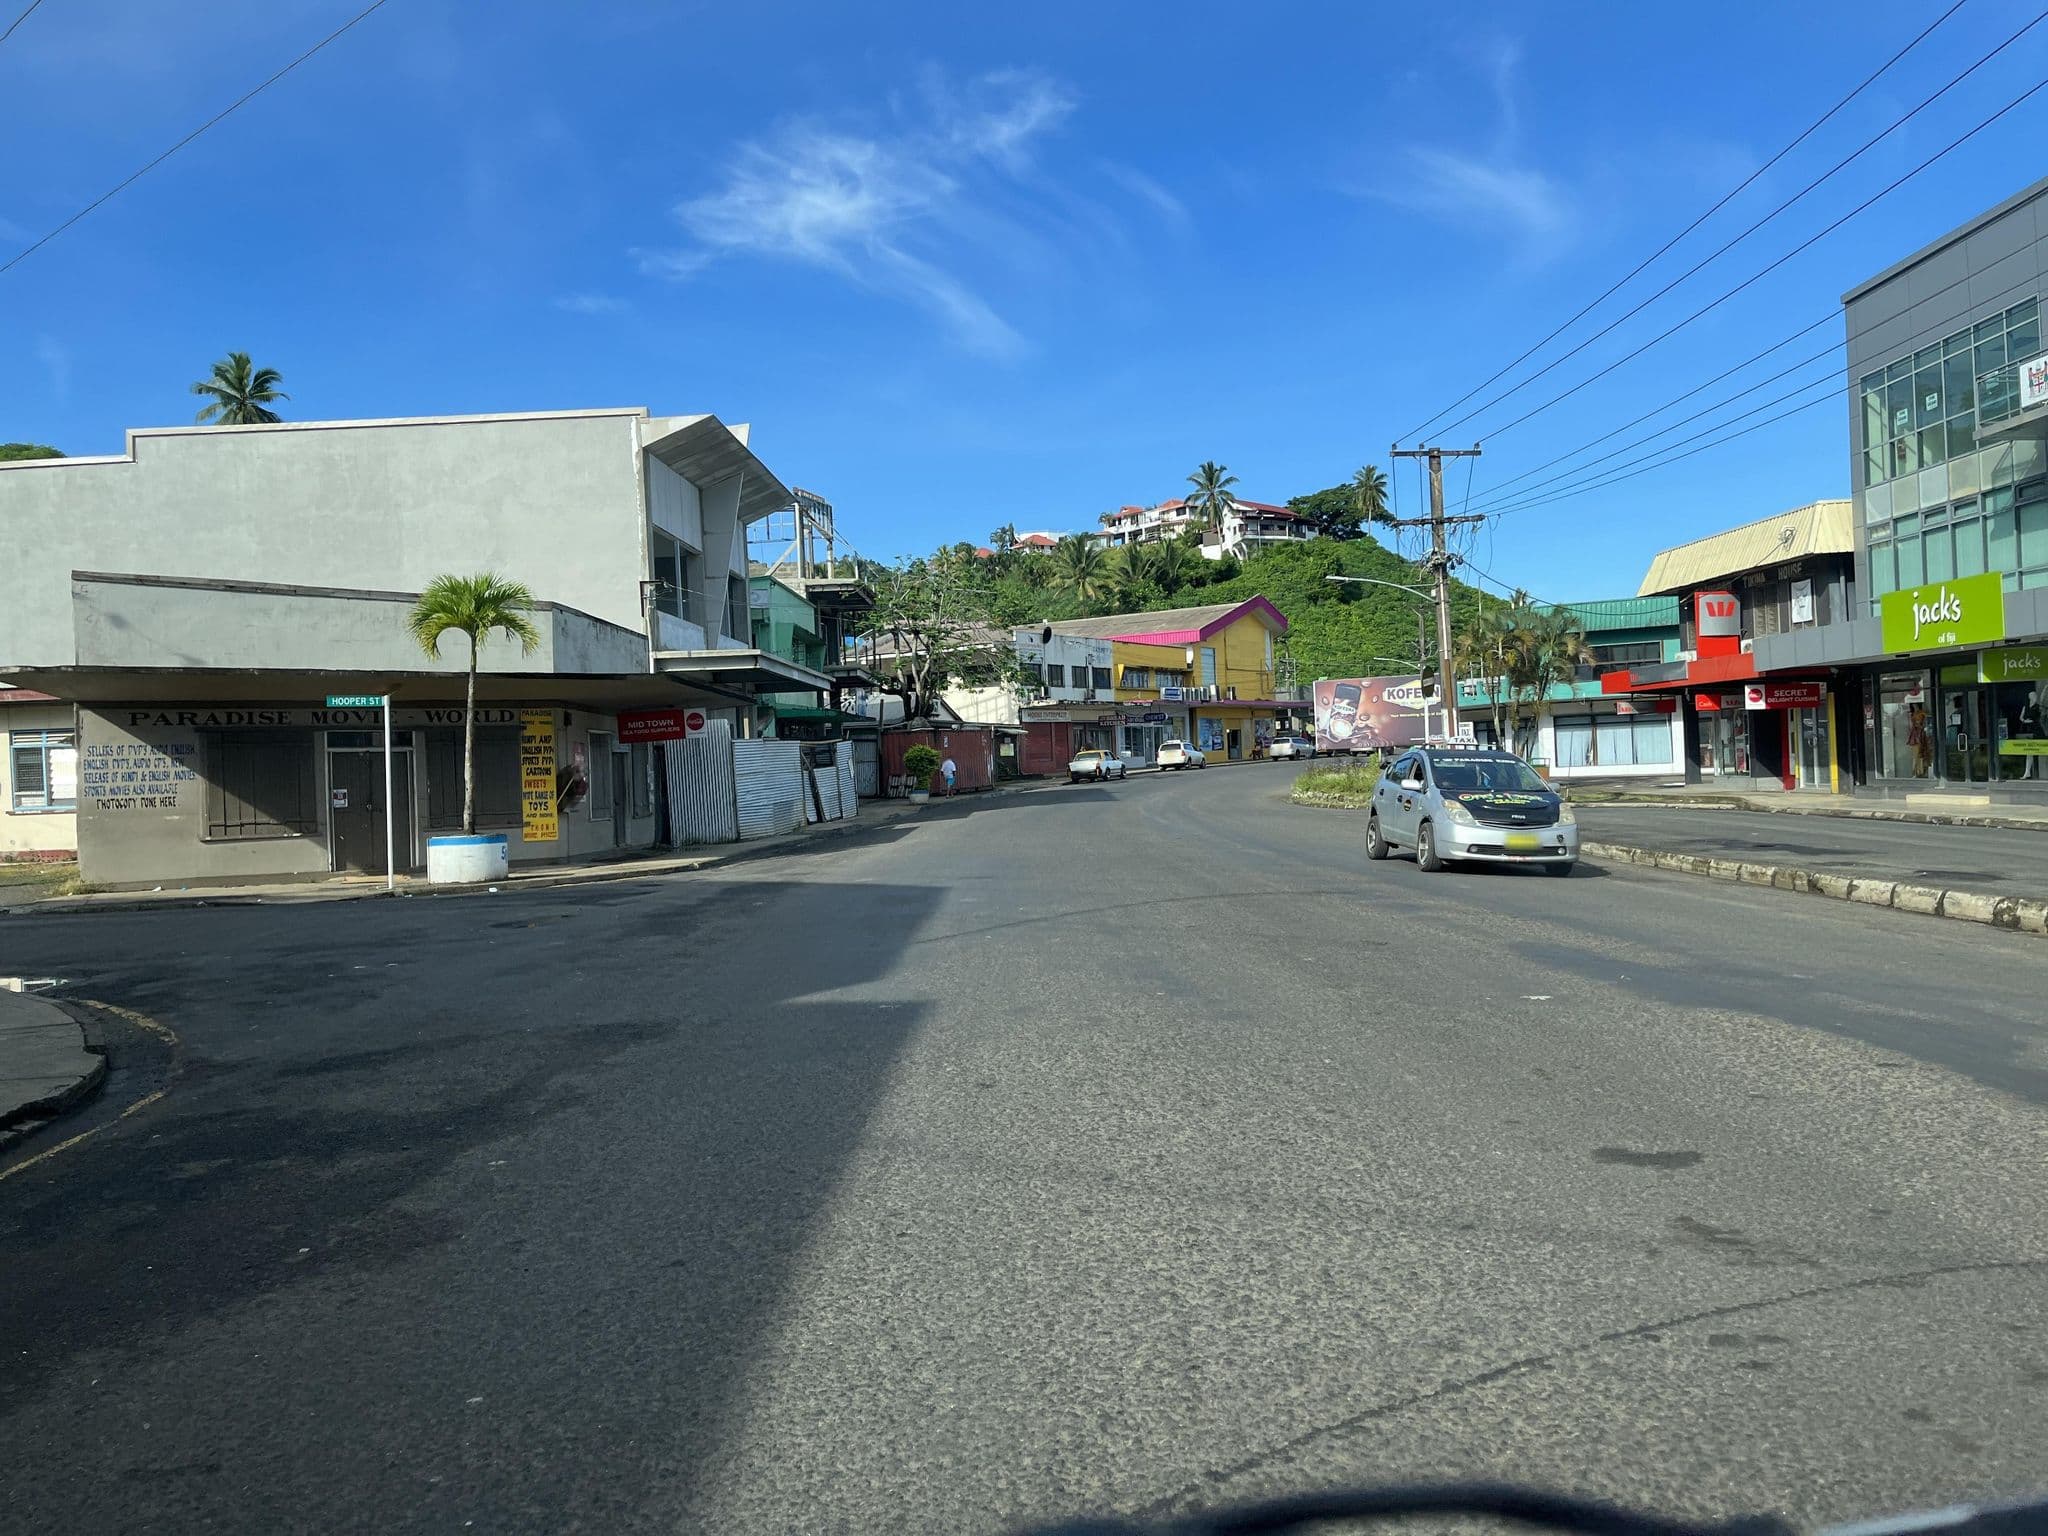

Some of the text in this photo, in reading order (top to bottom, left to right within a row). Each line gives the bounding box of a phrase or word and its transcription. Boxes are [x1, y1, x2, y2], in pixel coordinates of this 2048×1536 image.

[1777, 561, 1803, 581] HOUSE
[1912, 586, 1962, 641] jack's
[1937, 633, 1946, 644] of
[2002, 652, 2041, 676] jack's
[1774, 689, 1807, 697] SECRET
[332, 696, 380, 705] HOOPER ST
[128, 711, 291, 726] PARADISE
[311, 709, 398, 725] MOVIE
[424, 709, 514, 724] WORLD
[628, 719, 674, 729] MID TOWN
[116, 744, 124, 756] OF
[83, 759, 109, 770] ENGLISH
[83, 772, 109, 784] RELEASE
[111, 771, 118, 783] OF
[132, 784, 146, 795] ALSO
[96, 798, 138, 810] PHOTOCOPY
[159, 796, 177, 808] HERE
[529, 801, 549, 811] TOYS
